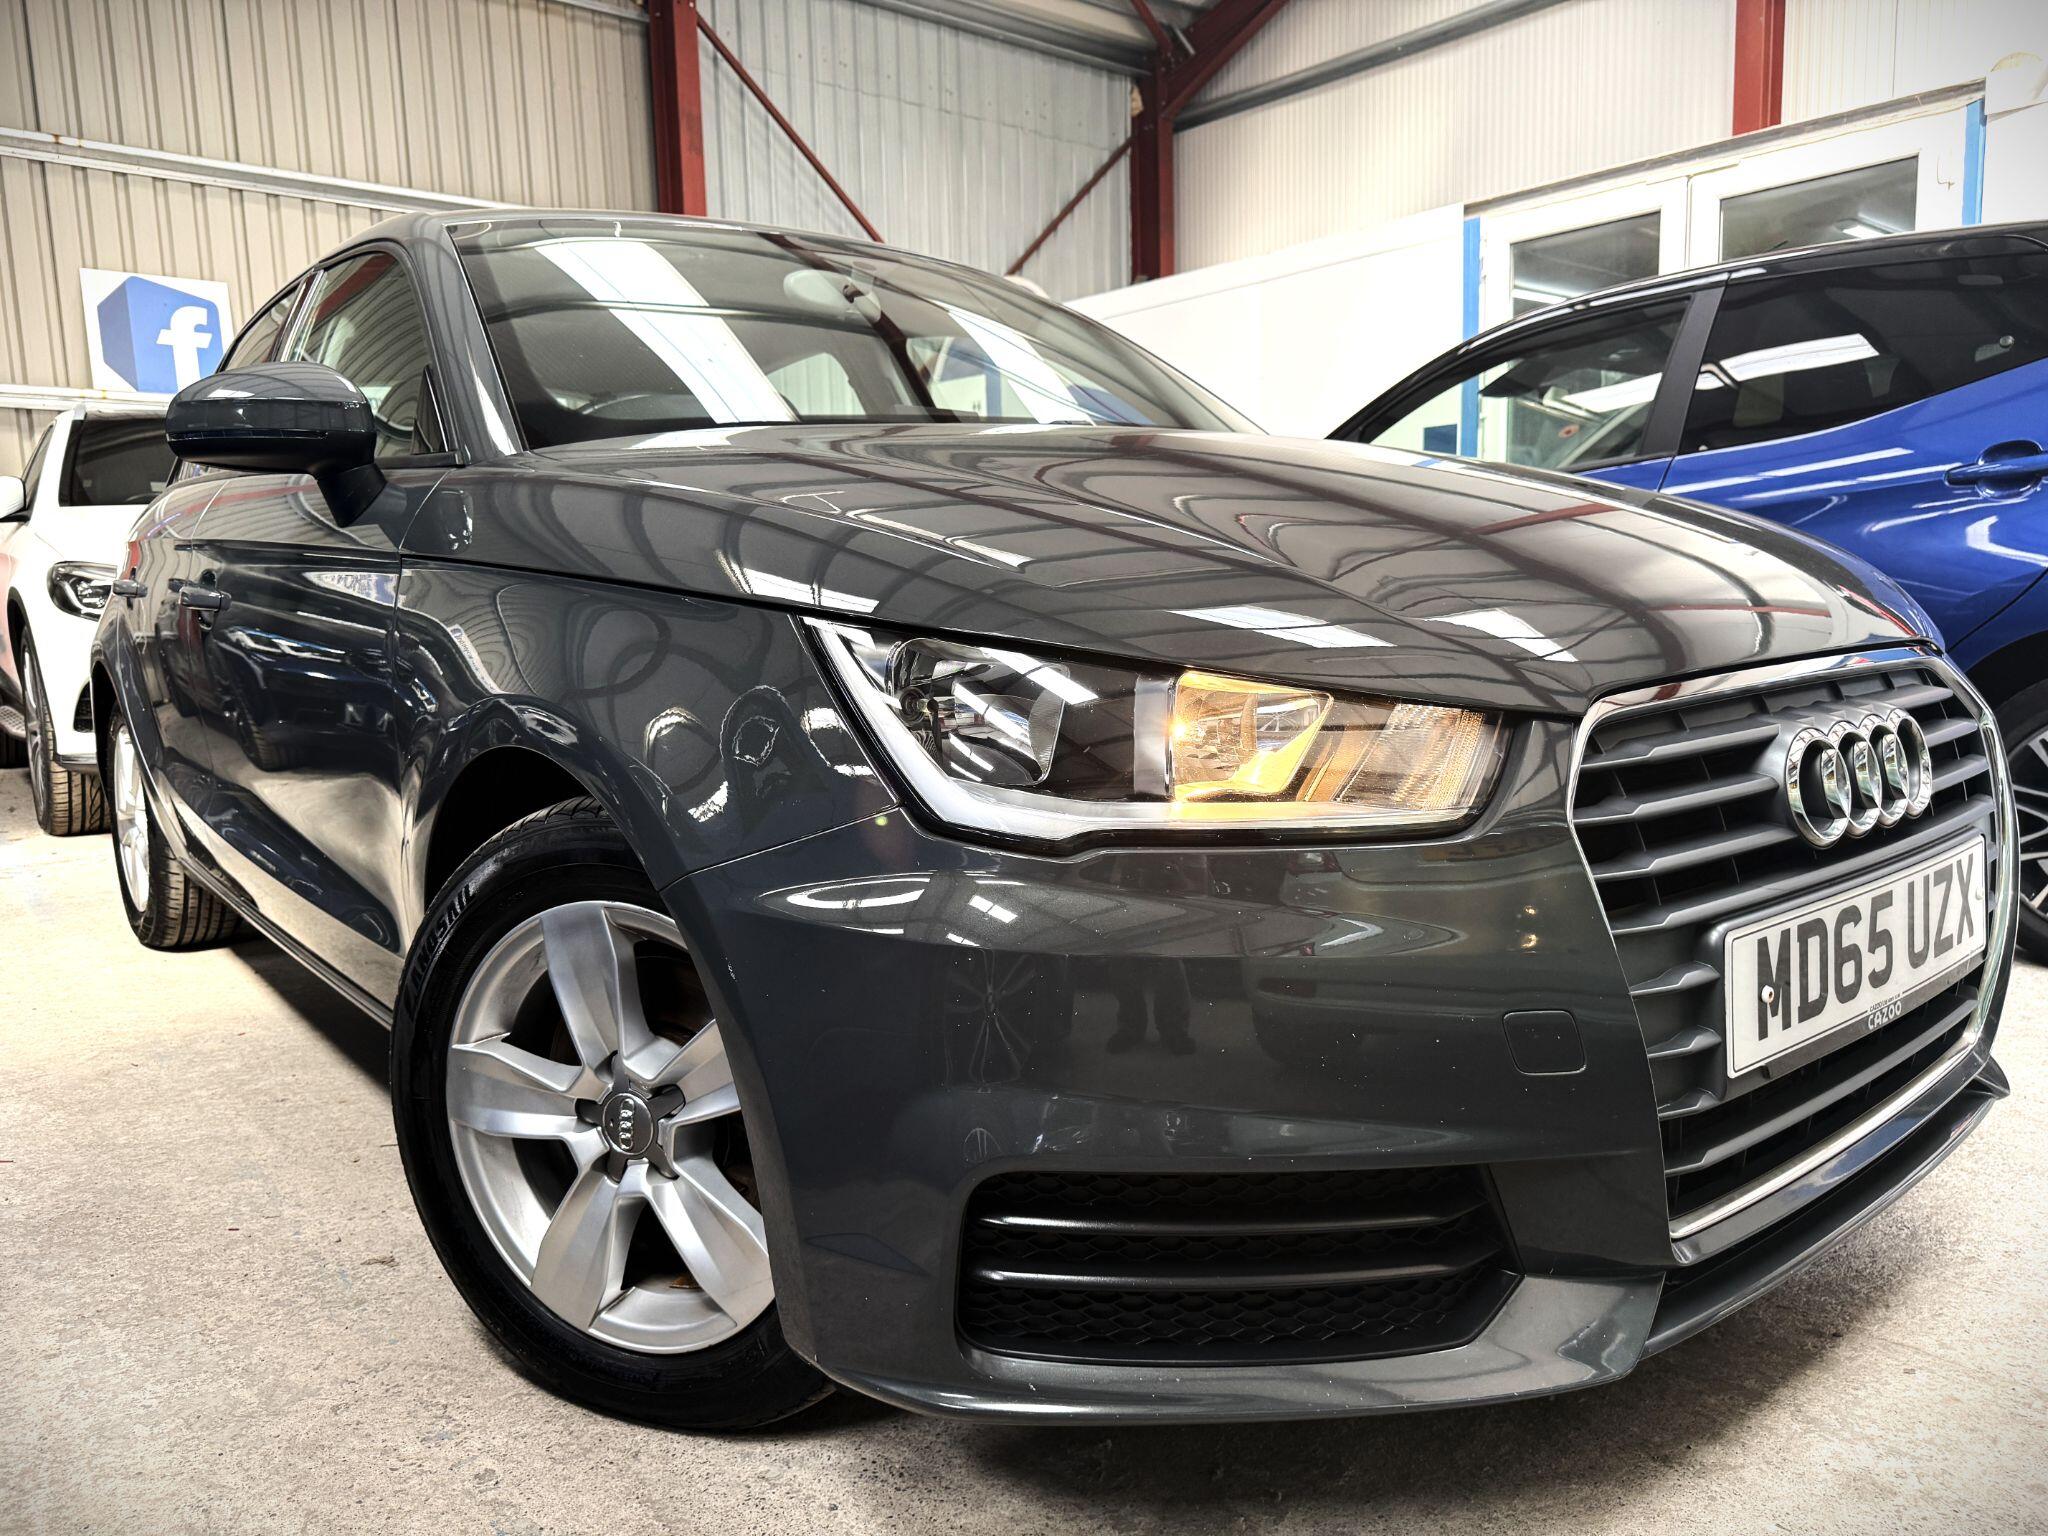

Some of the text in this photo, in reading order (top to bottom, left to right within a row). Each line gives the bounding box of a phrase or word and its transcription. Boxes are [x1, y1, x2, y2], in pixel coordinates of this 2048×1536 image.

[156, 305, 213, 394] f
[1757, 853, 1975, 1041] MD65 UZX
[1867, 1001, 1902, 1030] CAZOO
